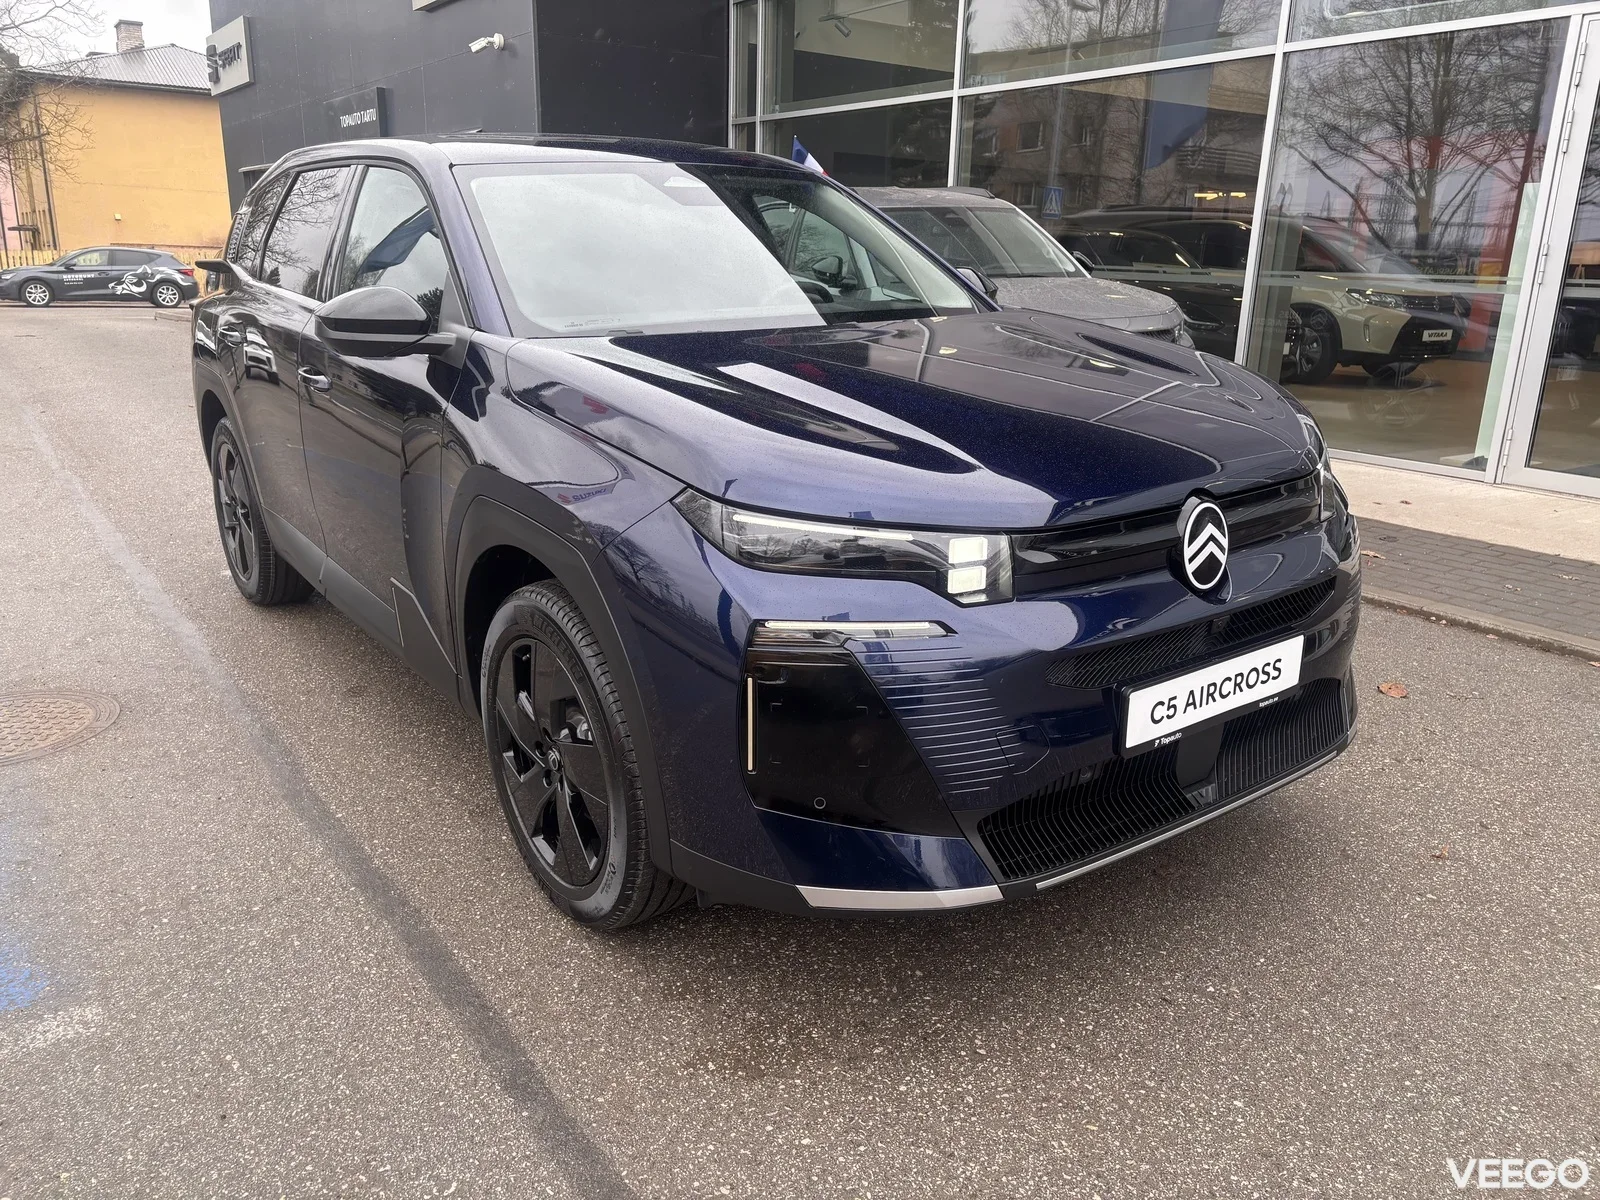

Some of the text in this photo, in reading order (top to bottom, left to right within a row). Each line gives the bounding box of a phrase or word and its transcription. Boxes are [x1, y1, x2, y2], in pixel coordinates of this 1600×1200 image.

[339, 108, 377, 128] TOPAUTO TARTU
[532, 613, 585, 685] MICHELIN
[1150, 658, 1282, 725] C5 AIRCROSS
[1160, 732, 1182, 745] Topauto
